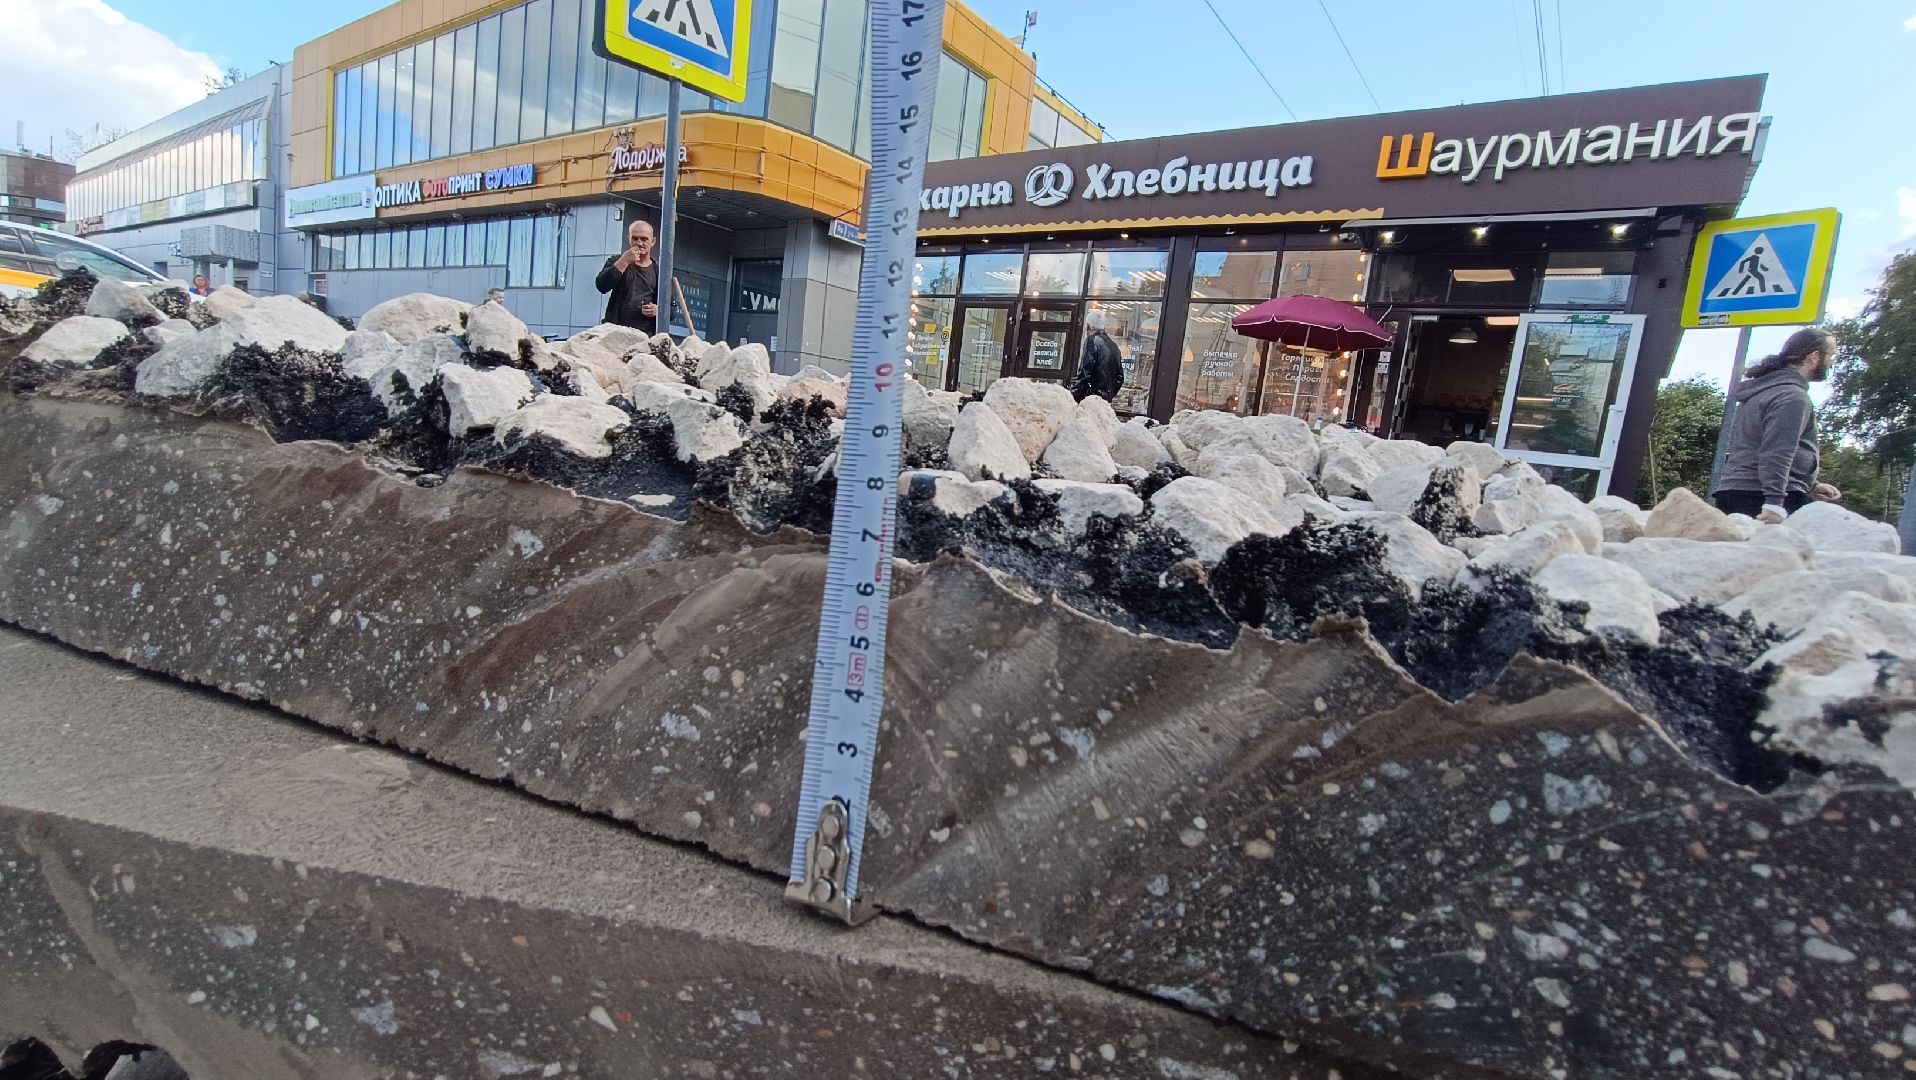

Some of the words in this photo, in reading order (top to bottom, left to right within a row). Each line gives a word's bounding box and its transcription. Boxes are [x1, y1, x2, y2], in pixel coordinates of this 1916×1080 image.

[902, 1, 925, 28] 17
[901, 51, 922, 81] 16
[899, 104, 919, 134] 15
[610, 144, 687, 172] Подружа
[1376, 111, 1761, 183] Шаурмания
[897, 155, 914, 184] 14
[1081, 155, 1314, 200] Хлебница
[375, 180, 421, 208] ОПТИКА
[485, 164, 534, 191] СУМКИ
[892, 207, 909, 235] 13
[888, 258, 904, 287] 12
[882, 313, 899, 339] 11
[1035, 340, 1058, 348] Всегда
[1203, 349, 1238, 359] Выпечка
[1201, 370, 1234, 378] работы
[1204, 360, 1234, 368] ручной
[875, 363, 894, 392] 10
[872, 424, 889, 438] 9
[867, 477, 884, 491] 8
[861, 528, 881, 542] 7
[856, 582, 875, 597] 6
[850, 635, 870, 650] 5
[844, 689, 865, 703] 4
[837, 741, 858, 758] 3
